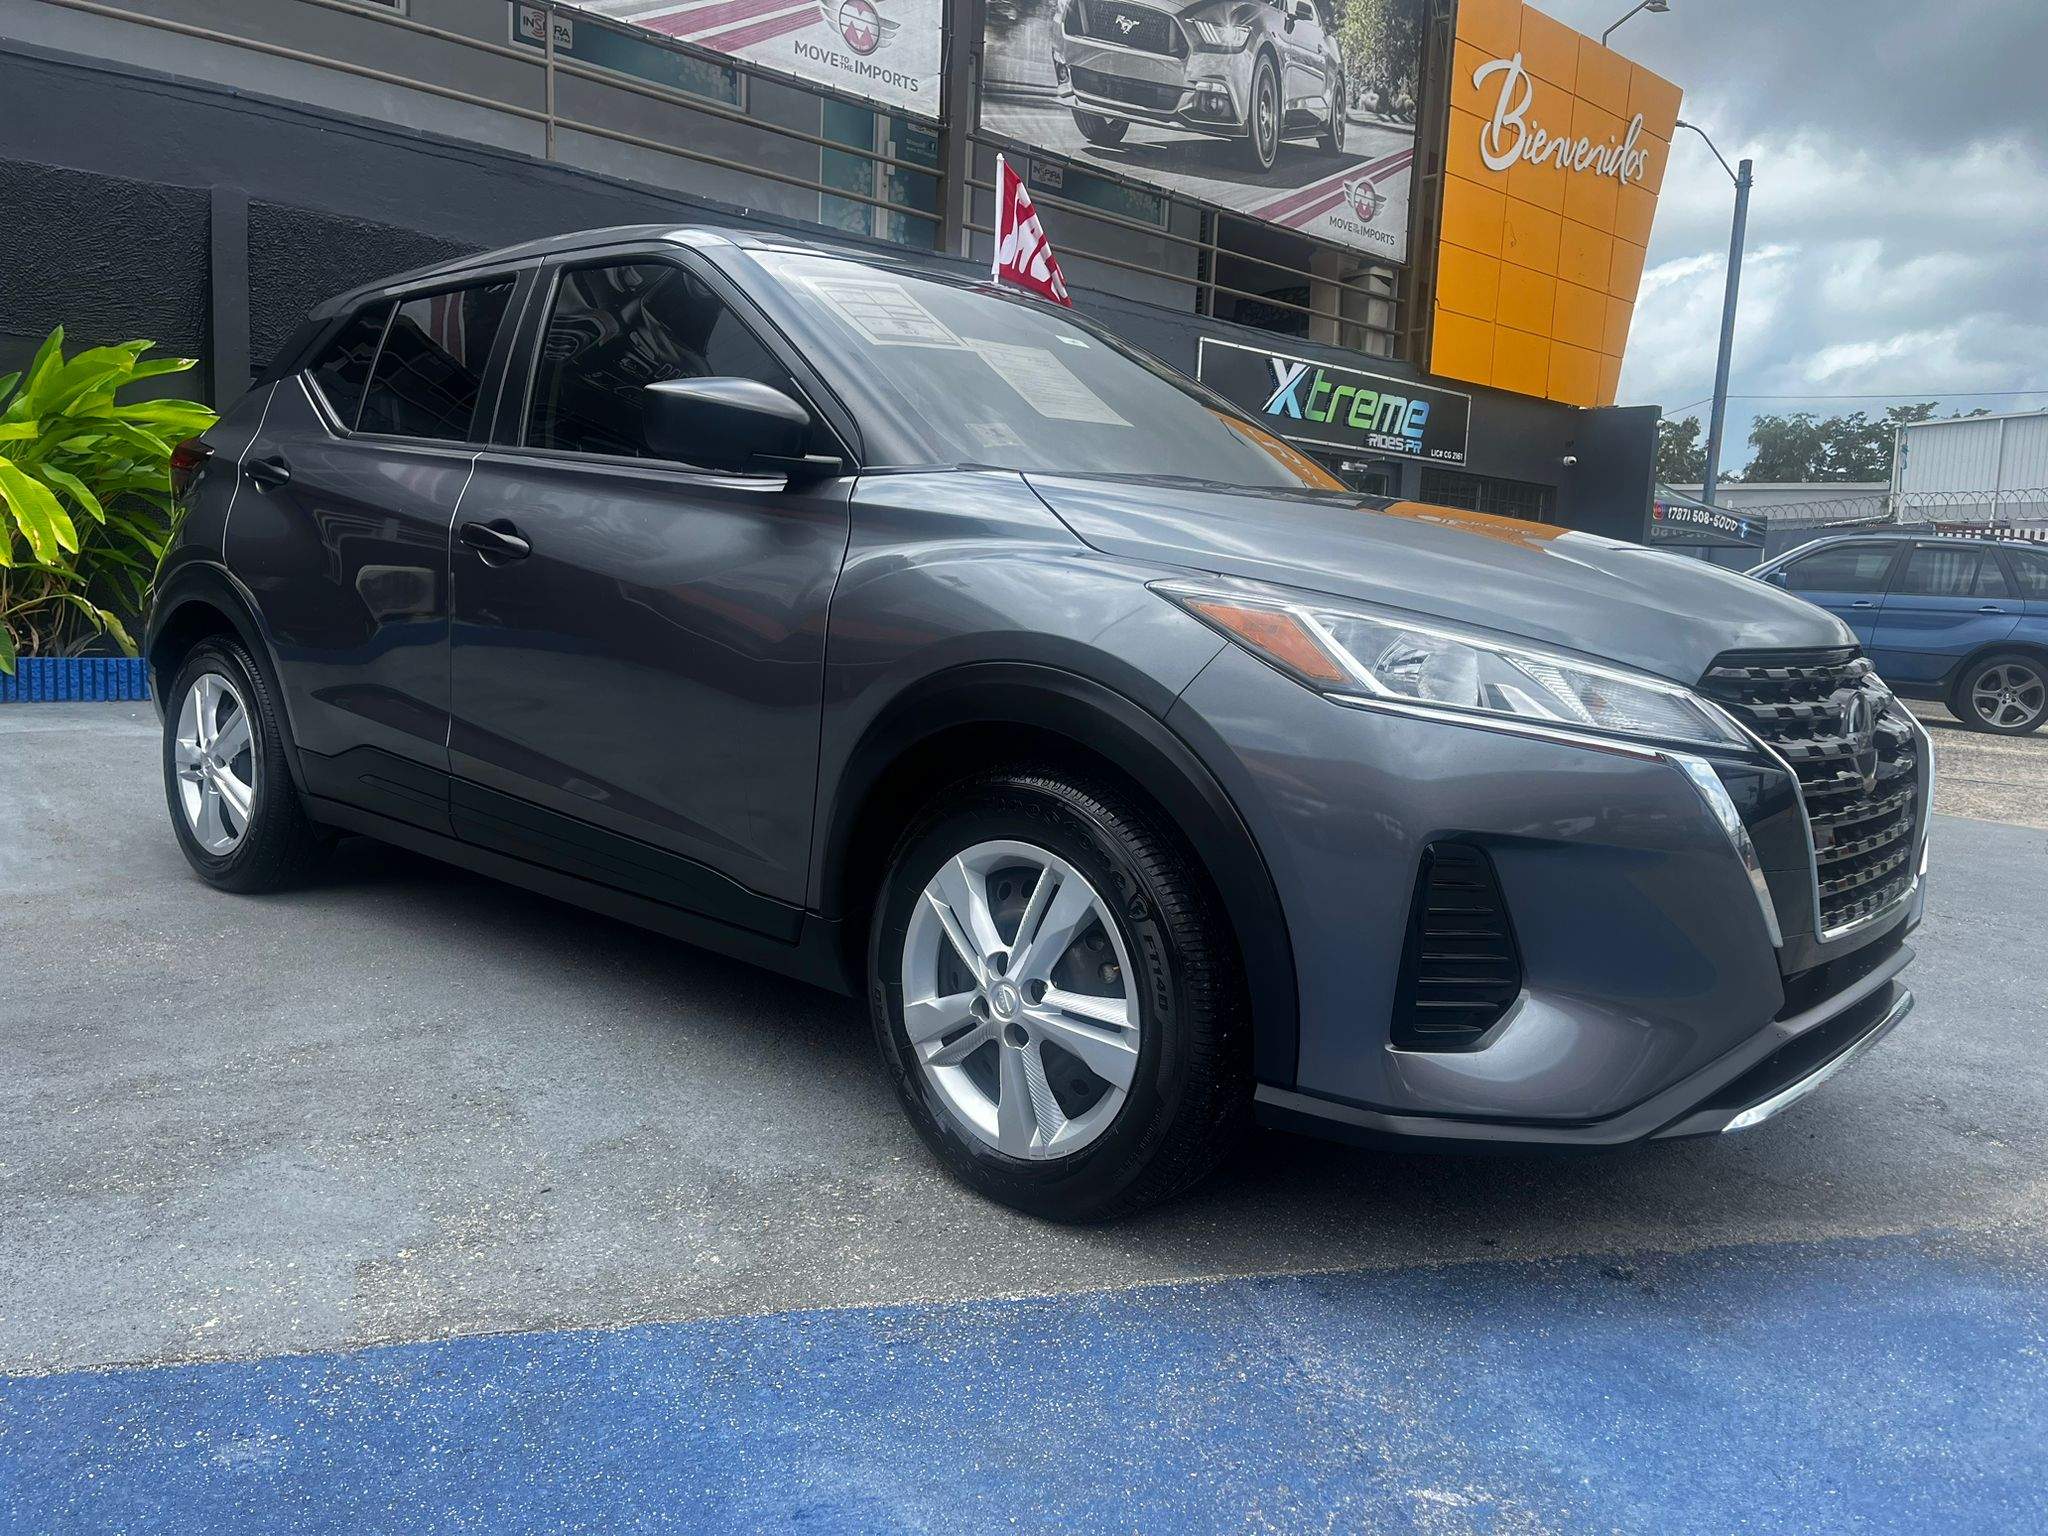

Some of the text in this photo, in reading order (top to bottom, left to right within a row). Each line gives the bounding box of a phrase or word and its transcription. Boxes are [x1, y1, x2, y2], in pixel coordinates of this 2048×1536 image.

[794, 40, 919, 92] MOVE TO THE IMPORTS
[1473, 52, 1648, 185] Bienvenidos
[1329, 215, 1353, 232] MOVE
[1361, 226, 1395, 245] IMPORTS
[1262, 357, 1430, 438] Xtreme
[1668, 507, 1738, 532] (787) 508-5000
